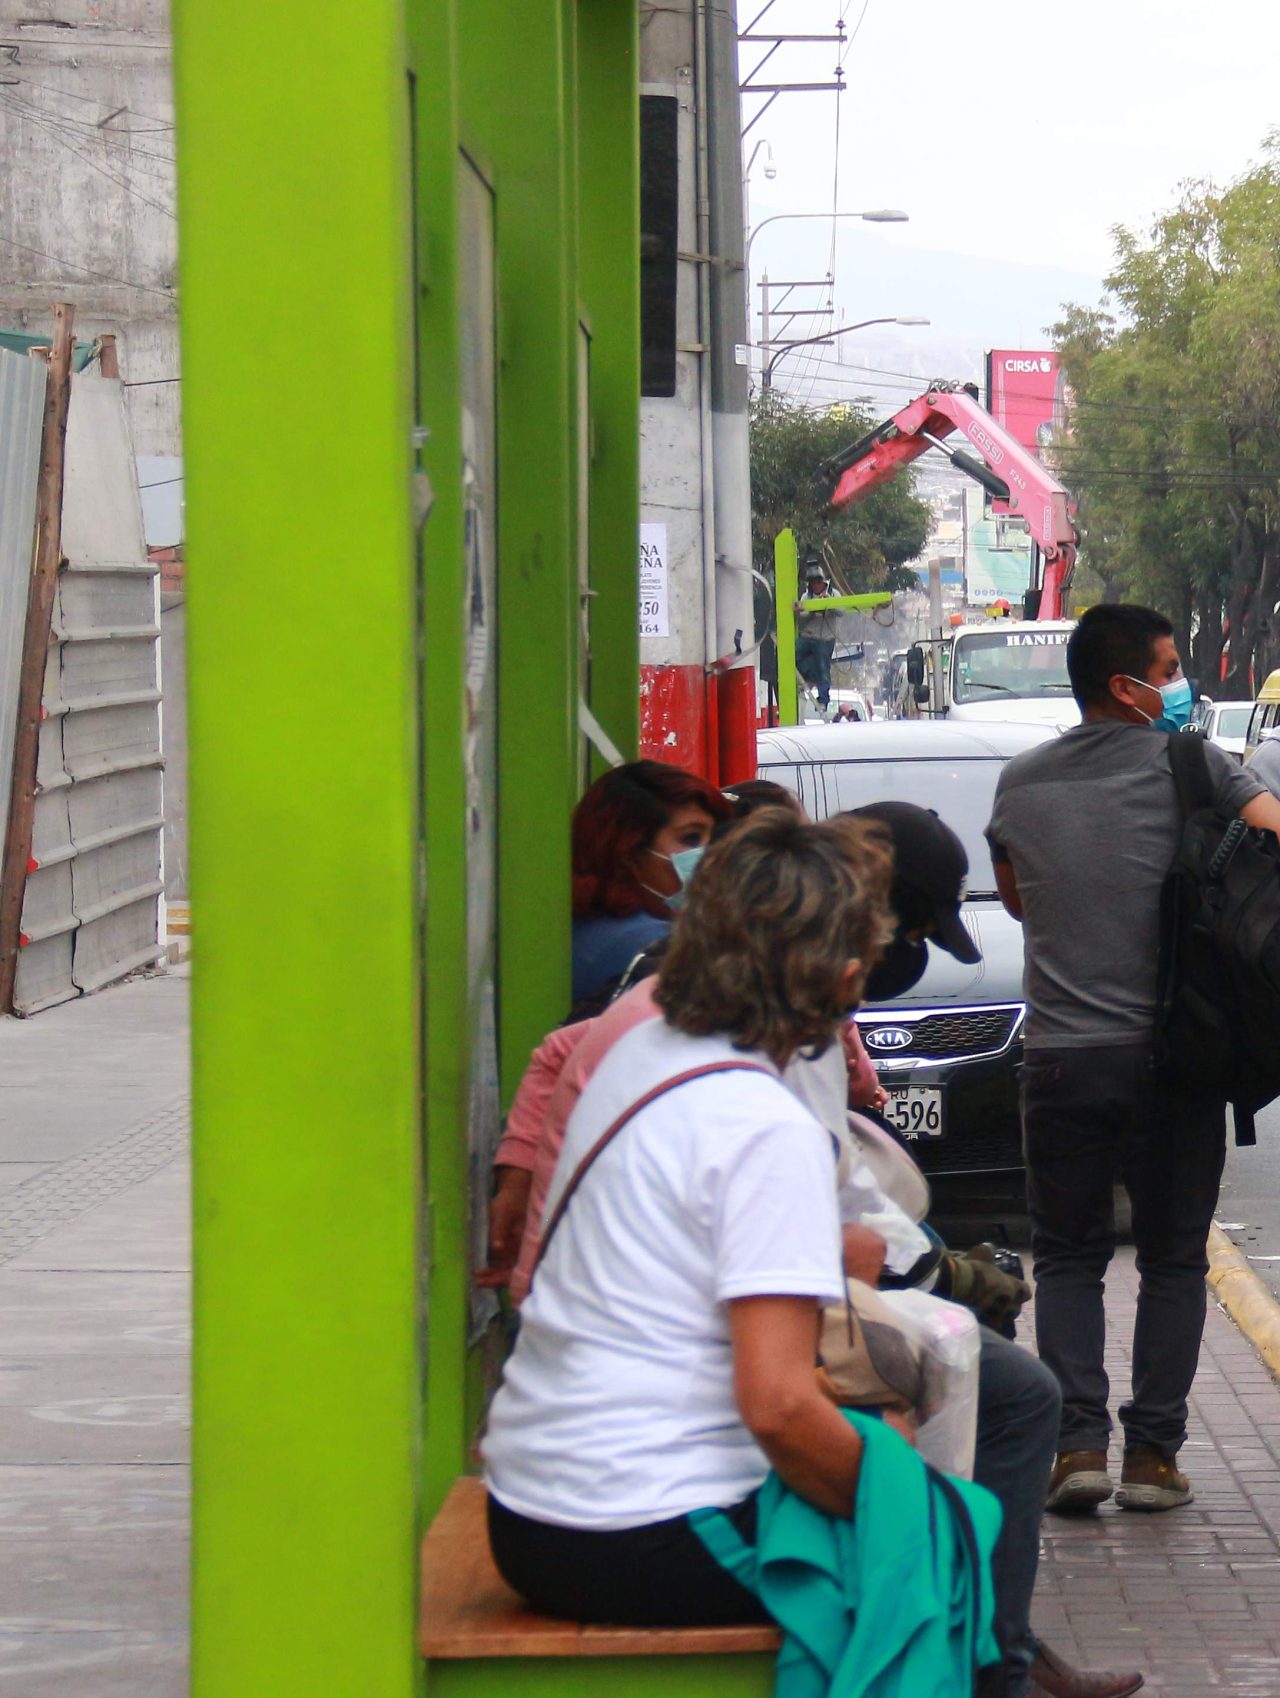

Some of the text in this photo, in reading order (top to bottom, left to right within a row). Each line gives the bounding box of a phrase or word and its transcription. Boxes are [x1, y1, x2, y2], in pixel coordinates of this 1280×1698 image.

[1005, 360, 1040, 372] CIRSA
[969, 423, 1003, 463] FASSI
[873, 1032, 906, 1045] KIA
